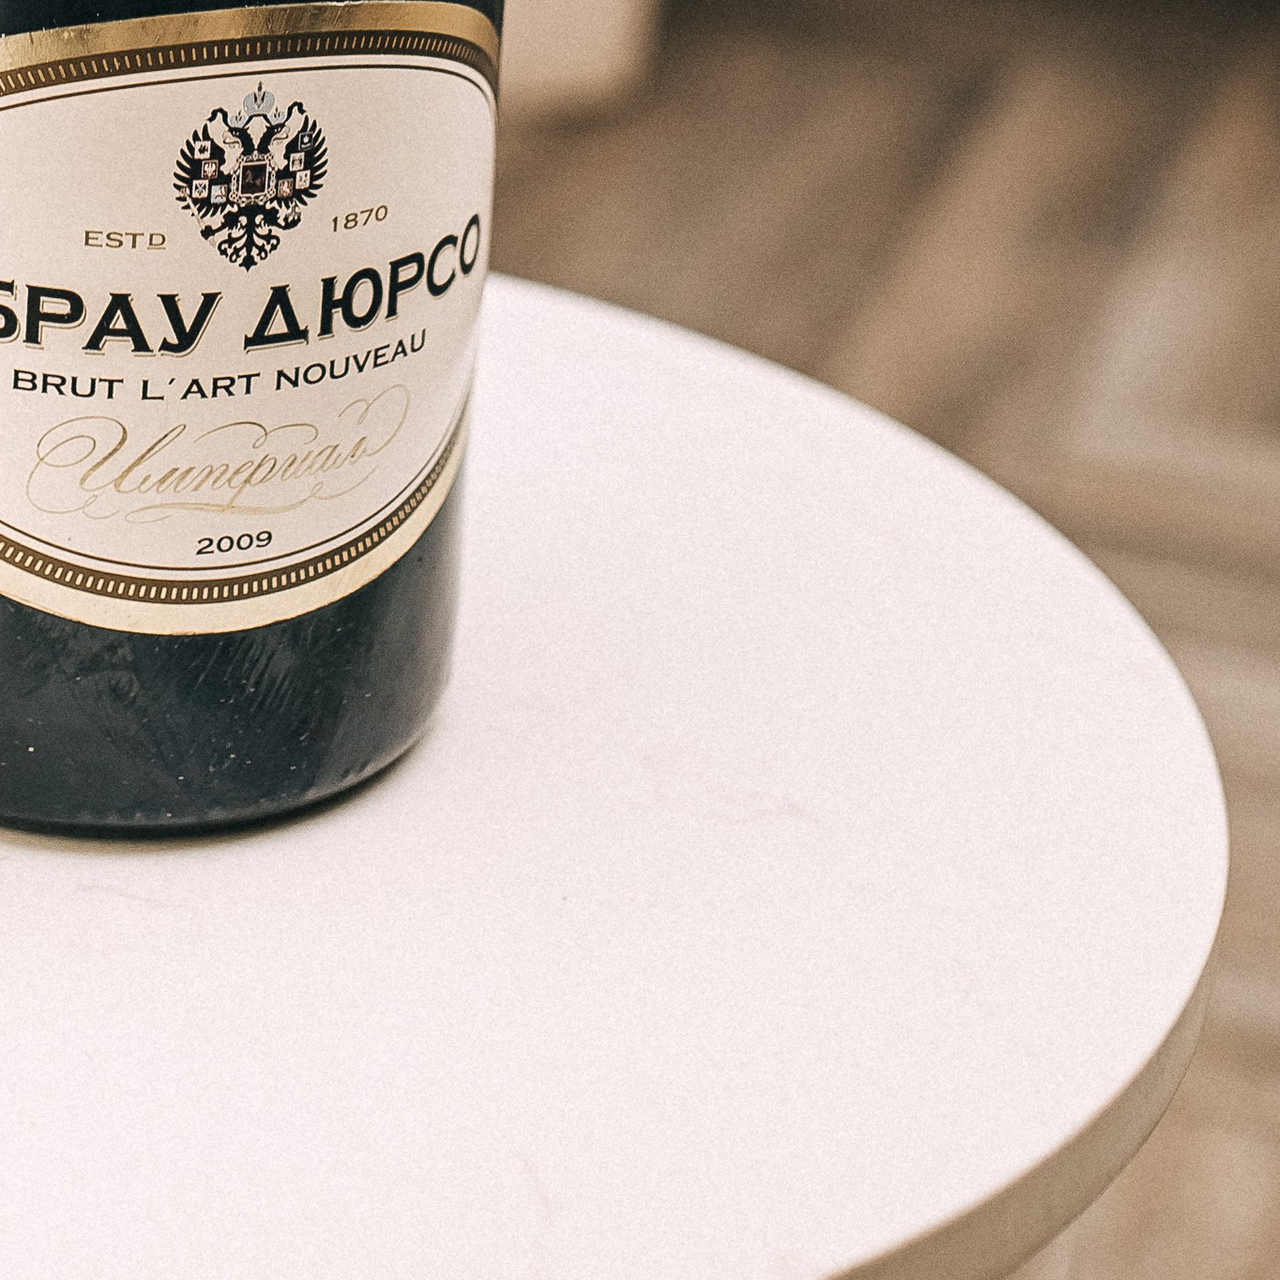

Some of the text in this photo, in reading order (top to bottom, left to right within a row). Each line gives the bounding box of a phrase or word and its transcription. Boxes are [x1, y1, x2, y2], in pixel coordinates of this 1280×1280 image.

[83, 206, 389, 250] ESTD 1870
[244, 214, 481, 353] ДЮРСО
[12, 329, 427, 401] BRUT L'ART NOUVEAU
[195, 531, 274, 555] 2009
